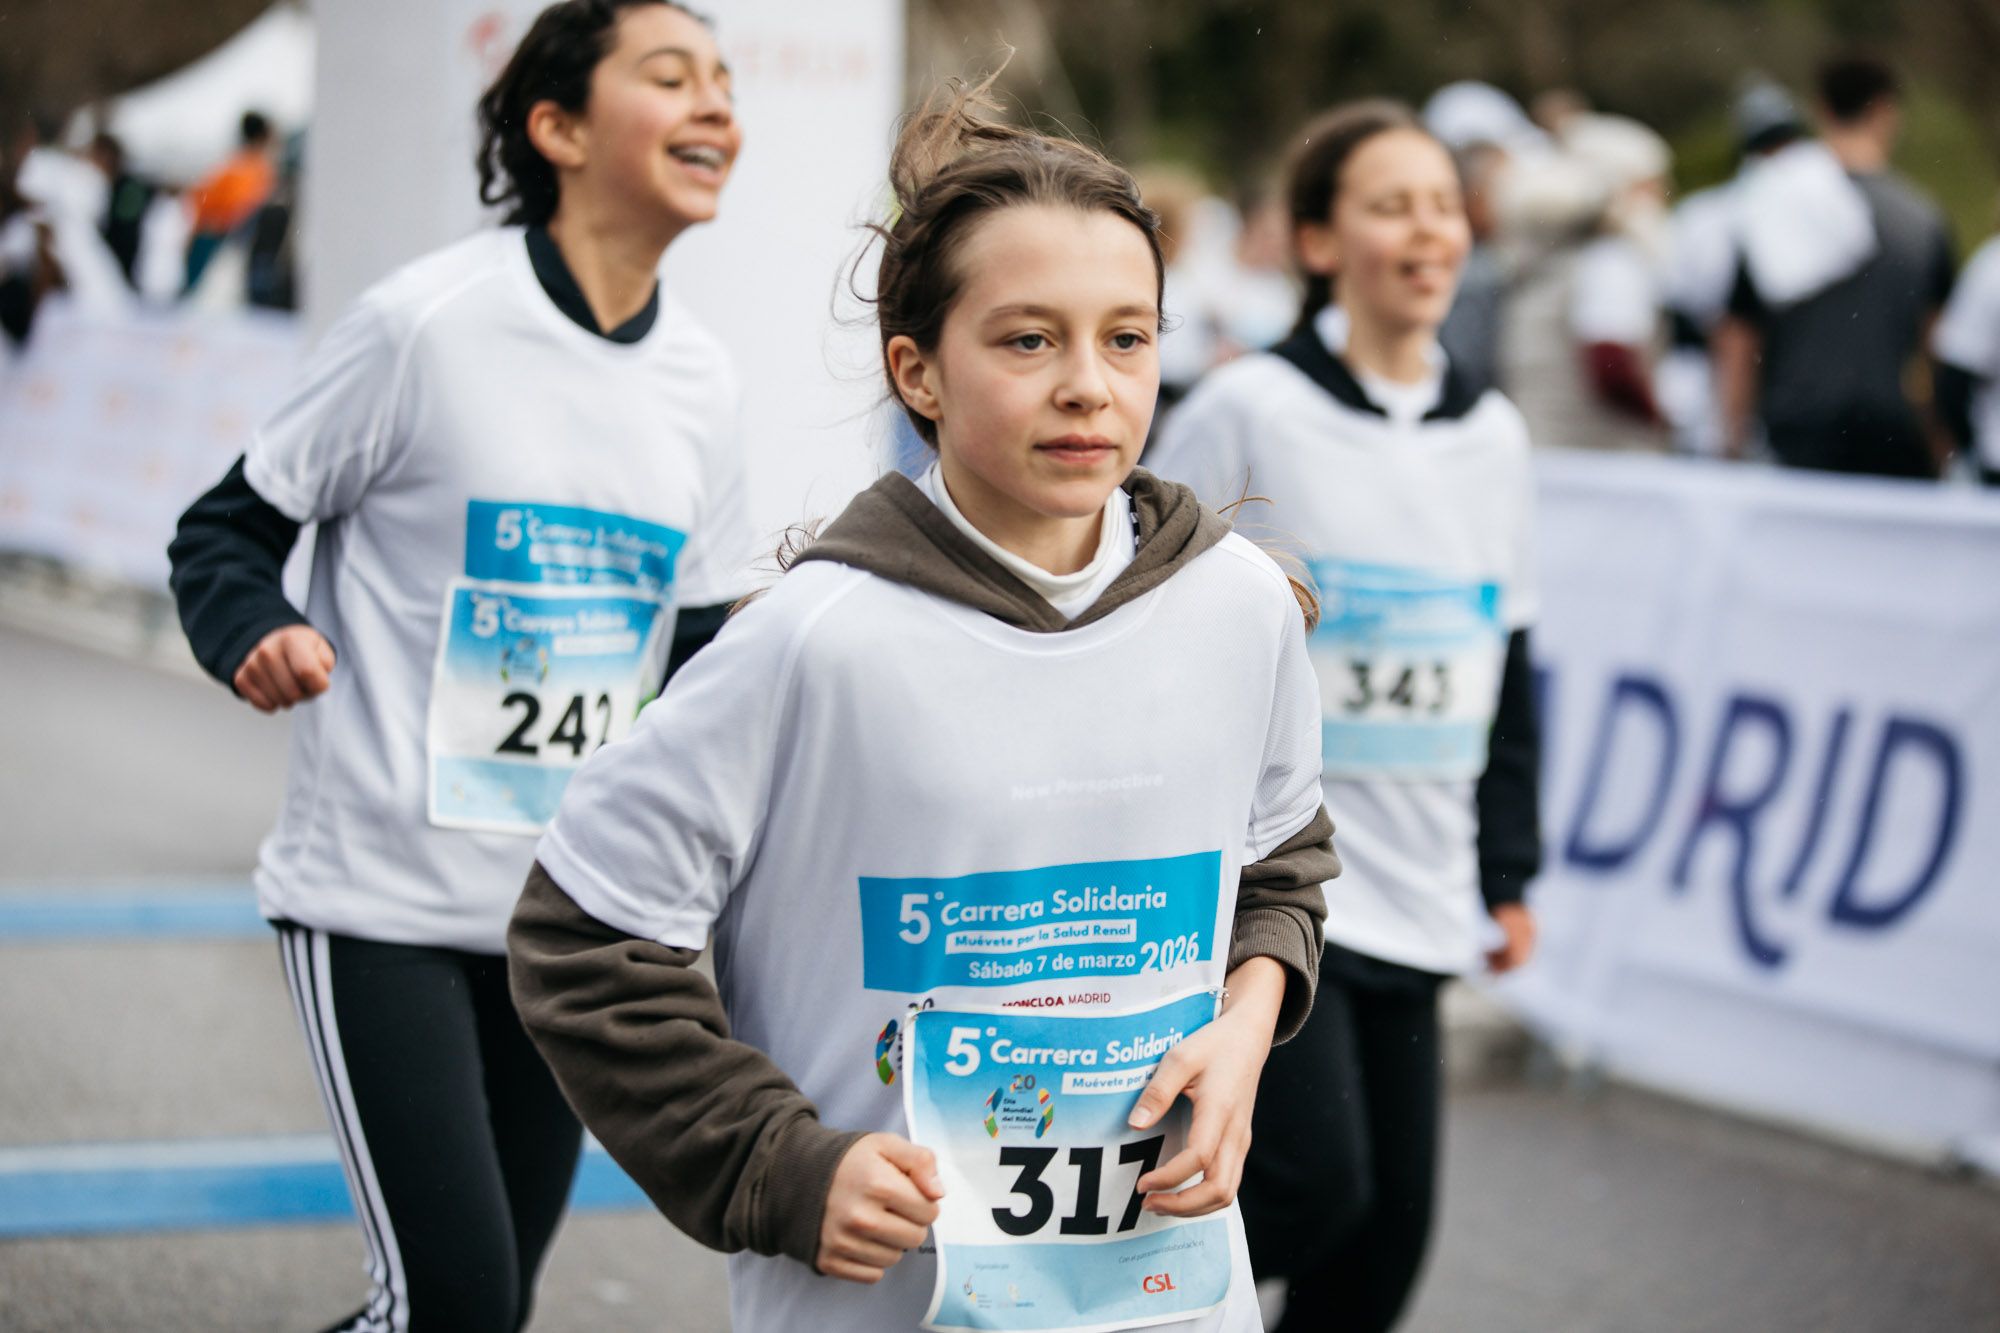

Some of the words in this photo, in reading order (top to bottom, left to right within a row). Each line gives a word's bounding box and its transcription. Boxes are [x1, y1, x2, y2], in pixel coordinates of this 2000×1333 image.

[1534, 663, 1966, 969] DRID
[941, 901, 1044, 926] Carrera
[1051, 885, 1167, 914] Solidaria
[955, 935, 1013, 946] Muévete
[1017, 935, 1035, 947] por
[1039, 929, 1050, 940] la
[1053, 926, 1089, 939] Salud
[1093, 924, 1130, 936] Renal
[969, 958, 1033, 979] Sábado
[1037, 955, 1047, 972] 7
[1052, 953, 1074, 971] de
[1078, 954, 1136, 969] marzo
[1140, 932, 1199, 974] 2026
[1068, 993, 1111, 1004] MADRID
[990, 1039, 1098, 1066] Carrera
[1072, 1077, 1123, 1088] Muévete
[1127, 1076, 1141, 1087] por
[991, 1134, 1165, 1236] 317
[1142, 1273, 1176, 1294] CSL
